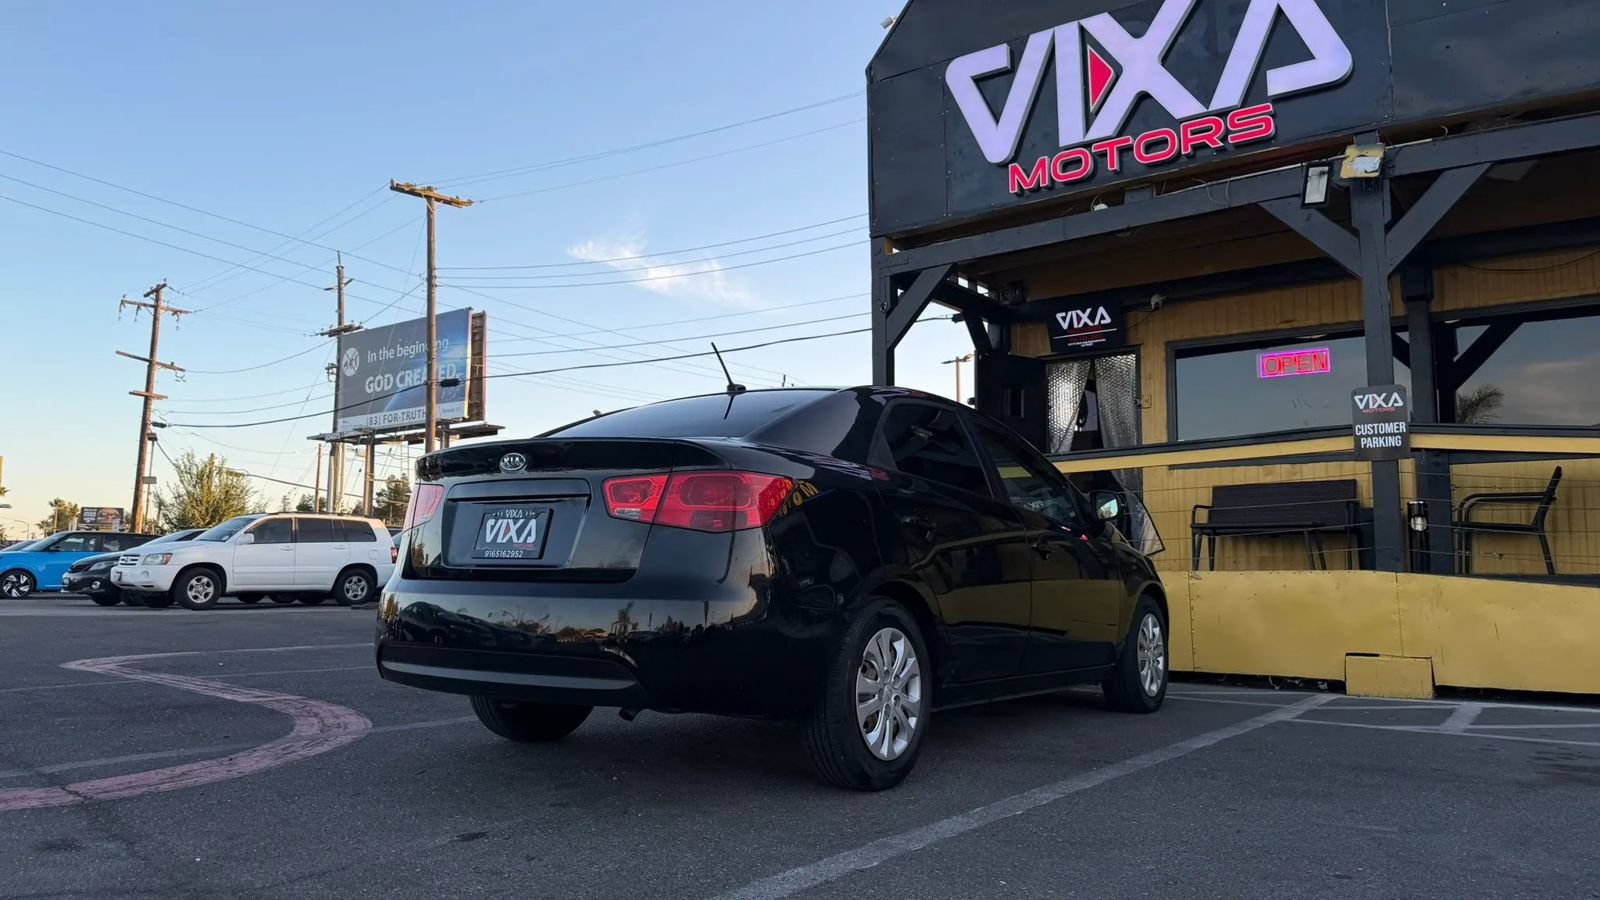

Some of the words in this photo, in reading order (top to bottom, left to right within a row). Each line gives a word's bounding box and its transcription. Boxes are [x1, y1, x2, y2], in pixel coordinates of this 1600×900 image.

[945, 0, 1353, 164] VIXA
[1008, 103, 1276, 194] MOTORS
[1056, 306, 1111, 330] VIXA
[368, 351, 377, 362] In
[379, 347, 394, 360] the
[1263, 352, 1328, 375] OPEN
[365, 373, 394, 393] GOD
[1354, 392, 1404, 409] VIXA
[1355, 422, 1406, 436] CUSTOMER
[1361, 436, 1402, 448] PARKING
[503, 456, 521, 466] KIA
[505, 509, 523, 518] VIXA
[485, 519, 537, 543] VIXA
[484, 550, 524, 558] 9165162952
